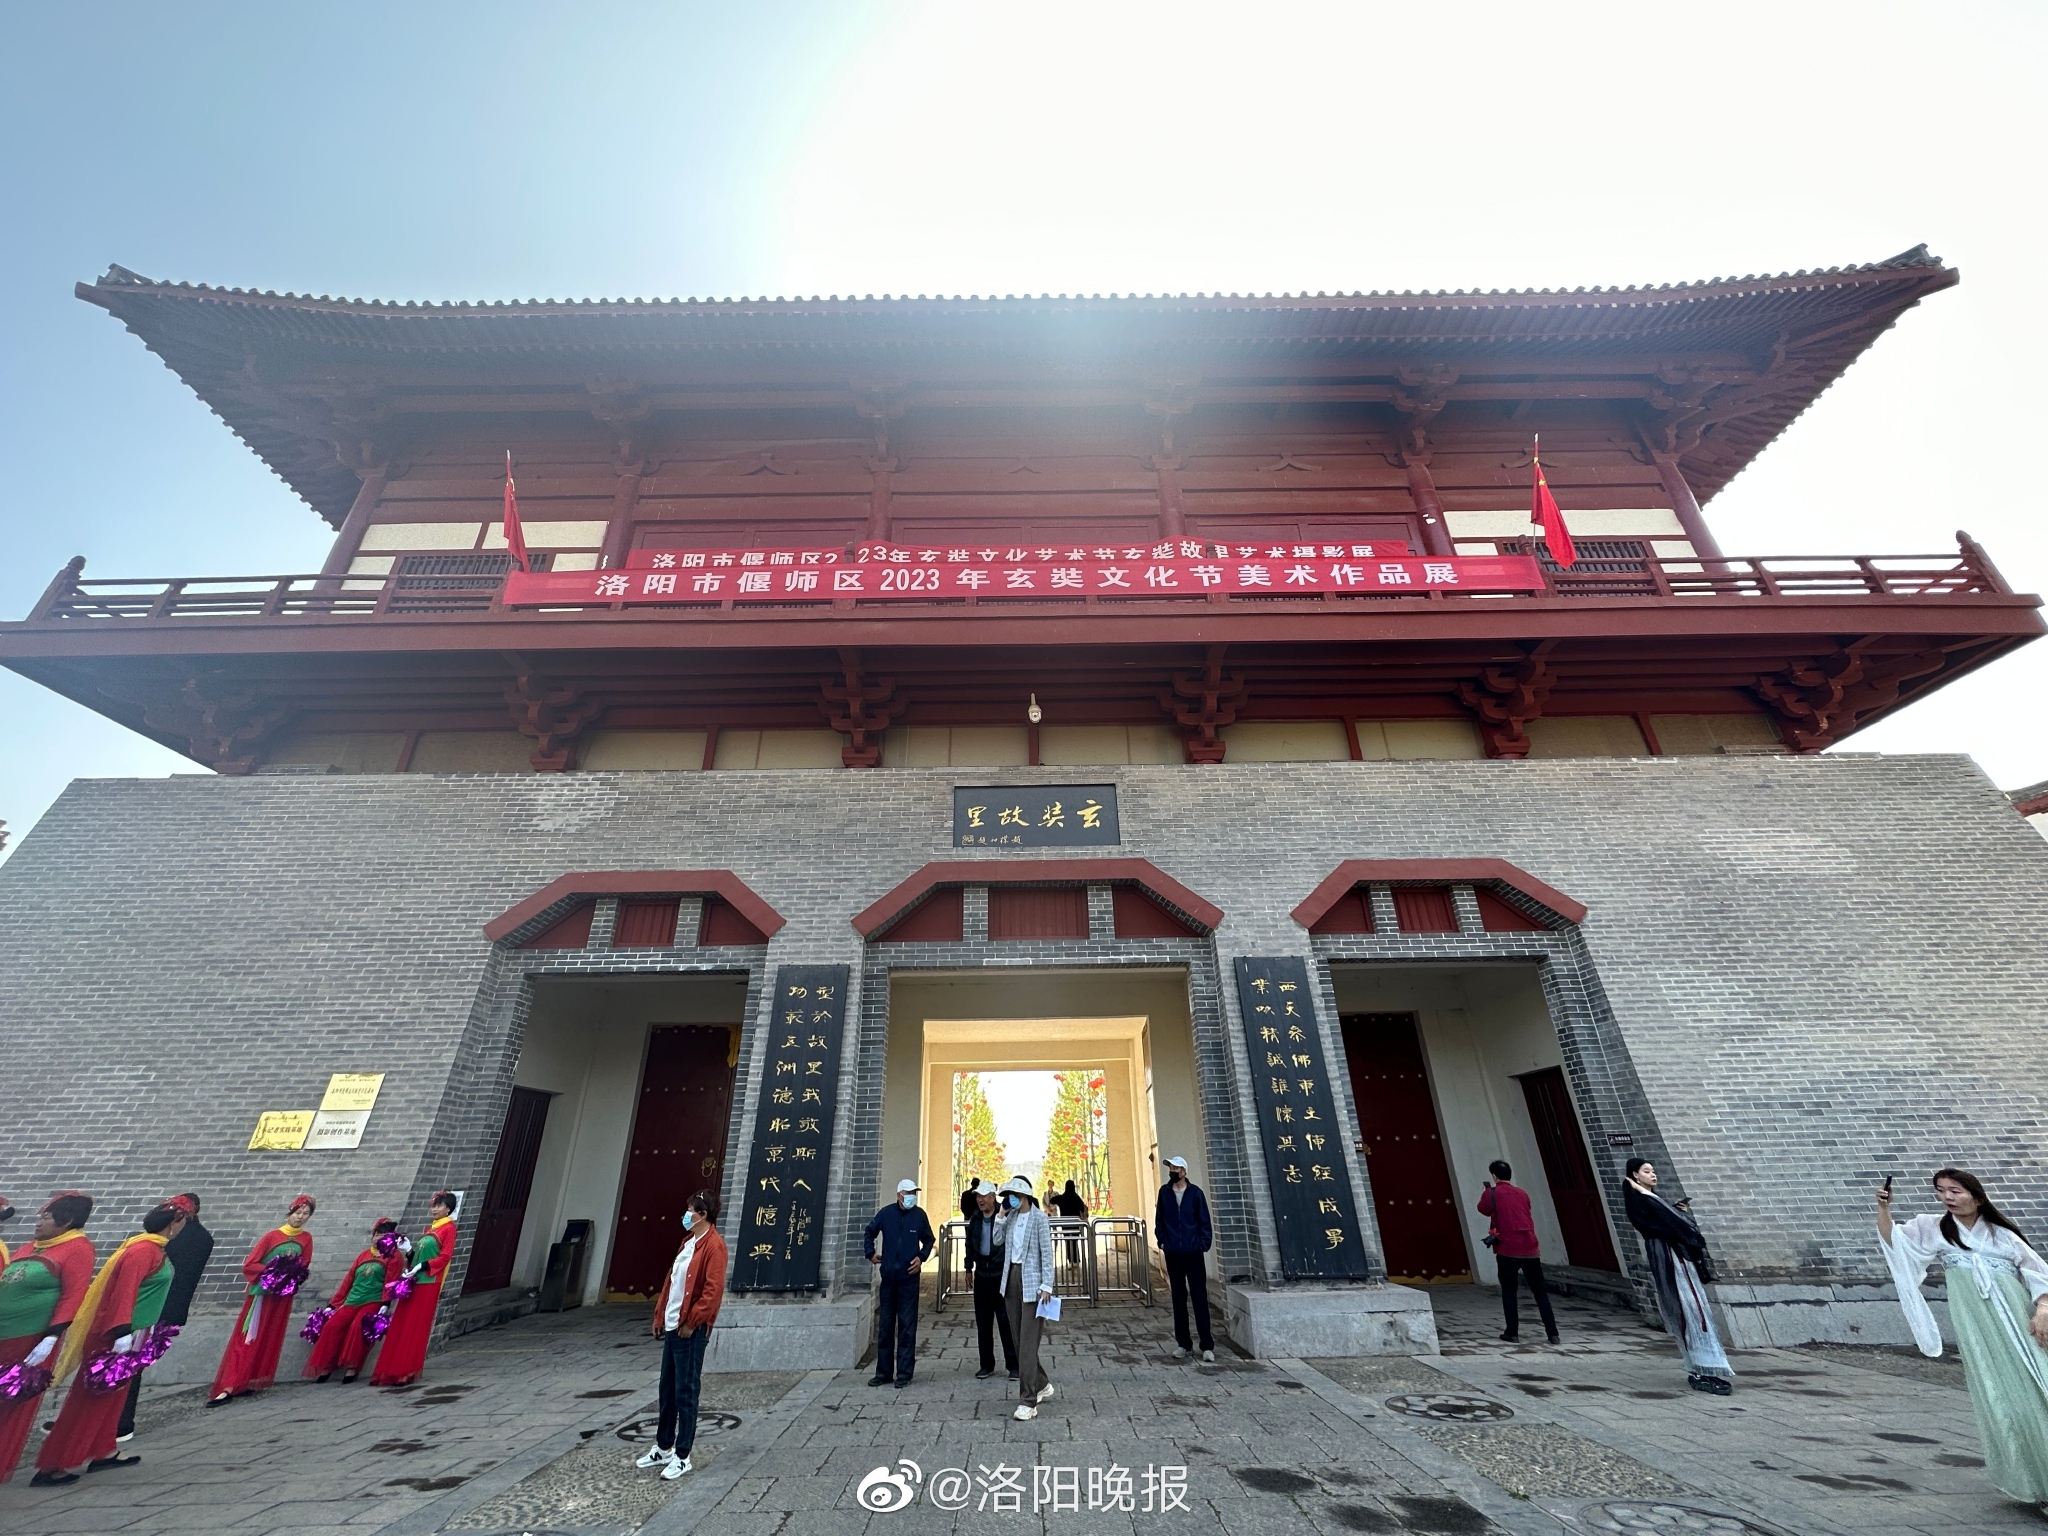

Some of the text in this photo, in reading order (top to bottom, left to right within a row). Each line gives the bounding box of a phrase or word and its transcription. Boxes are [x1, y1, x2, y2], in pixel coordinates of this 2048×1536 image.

[594, 563, 1459, 596] 洛阳市偃师区2023年玄奘文化节美术作品展
[967, 799, 1103, 829] 玄奘故里
